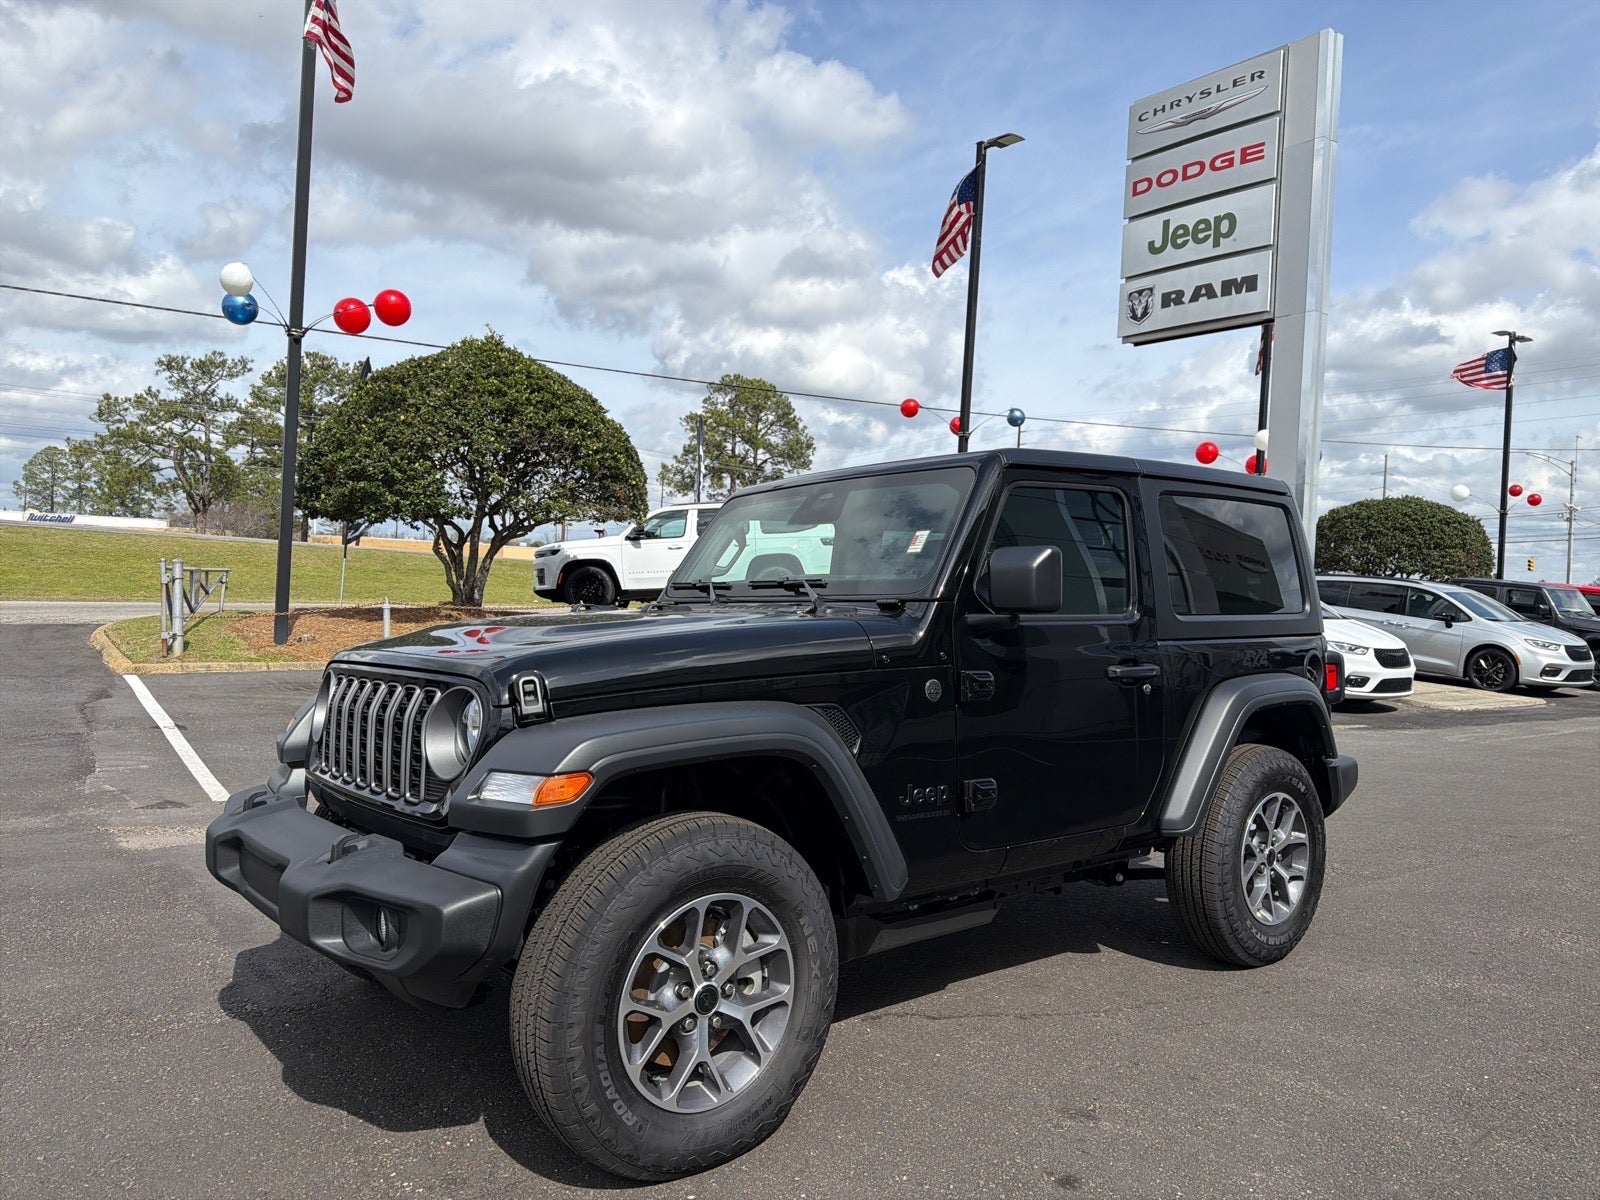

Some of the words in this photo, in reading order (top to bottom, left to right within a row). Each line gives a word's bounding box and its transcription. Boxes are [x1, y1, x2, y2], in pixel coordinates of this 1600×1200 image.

[1137, 69, 1266, 123] CHRYSLER
[1131, 141, 1266, 198] DODGE
[1147, 211, 1238, 256] Jeep
[1160, 273, 1259, 309] RAM
[26, 513, 75, 523] Twitchell
[898, 783, 949, 807] Jeep
[799, 915, 822, 1018] NEXE
